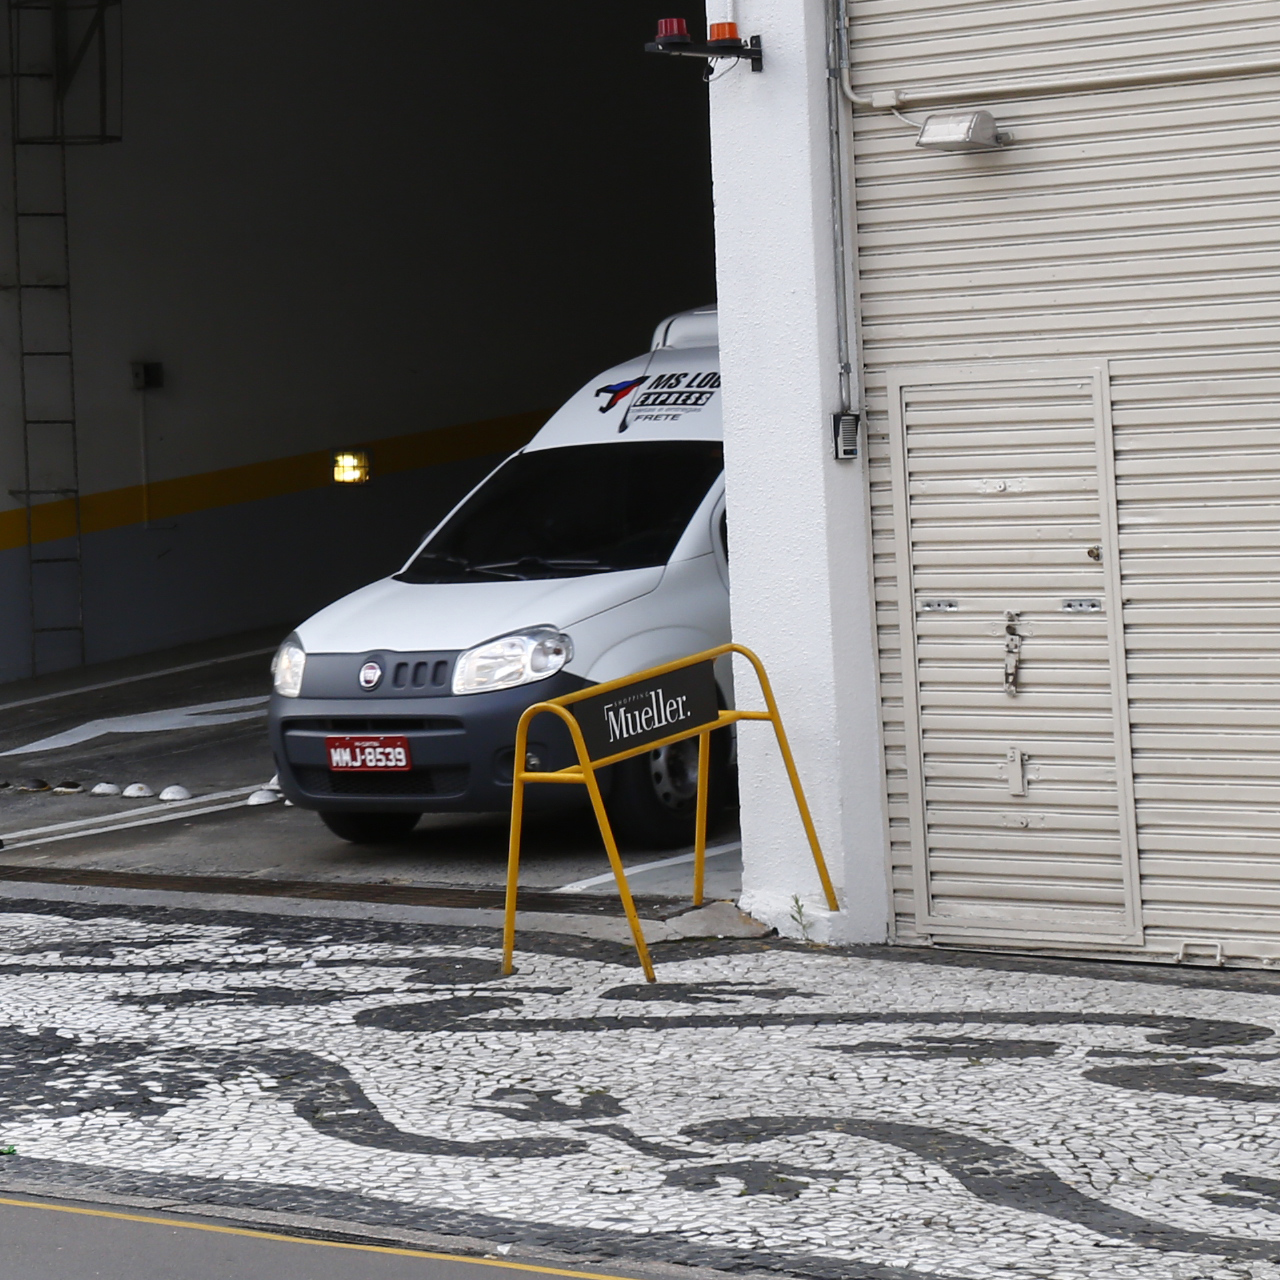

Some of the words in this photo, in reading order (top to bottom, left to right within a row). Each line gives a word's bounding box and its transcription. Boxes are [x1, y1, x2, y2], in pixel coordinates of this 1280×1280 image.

[647, 372, 689, 390] MS
[633, 392, 711, 407] EXPRESS
[634, 413, 683, 422] FRETE
[614, 691, 650, 707] SHOPPING
